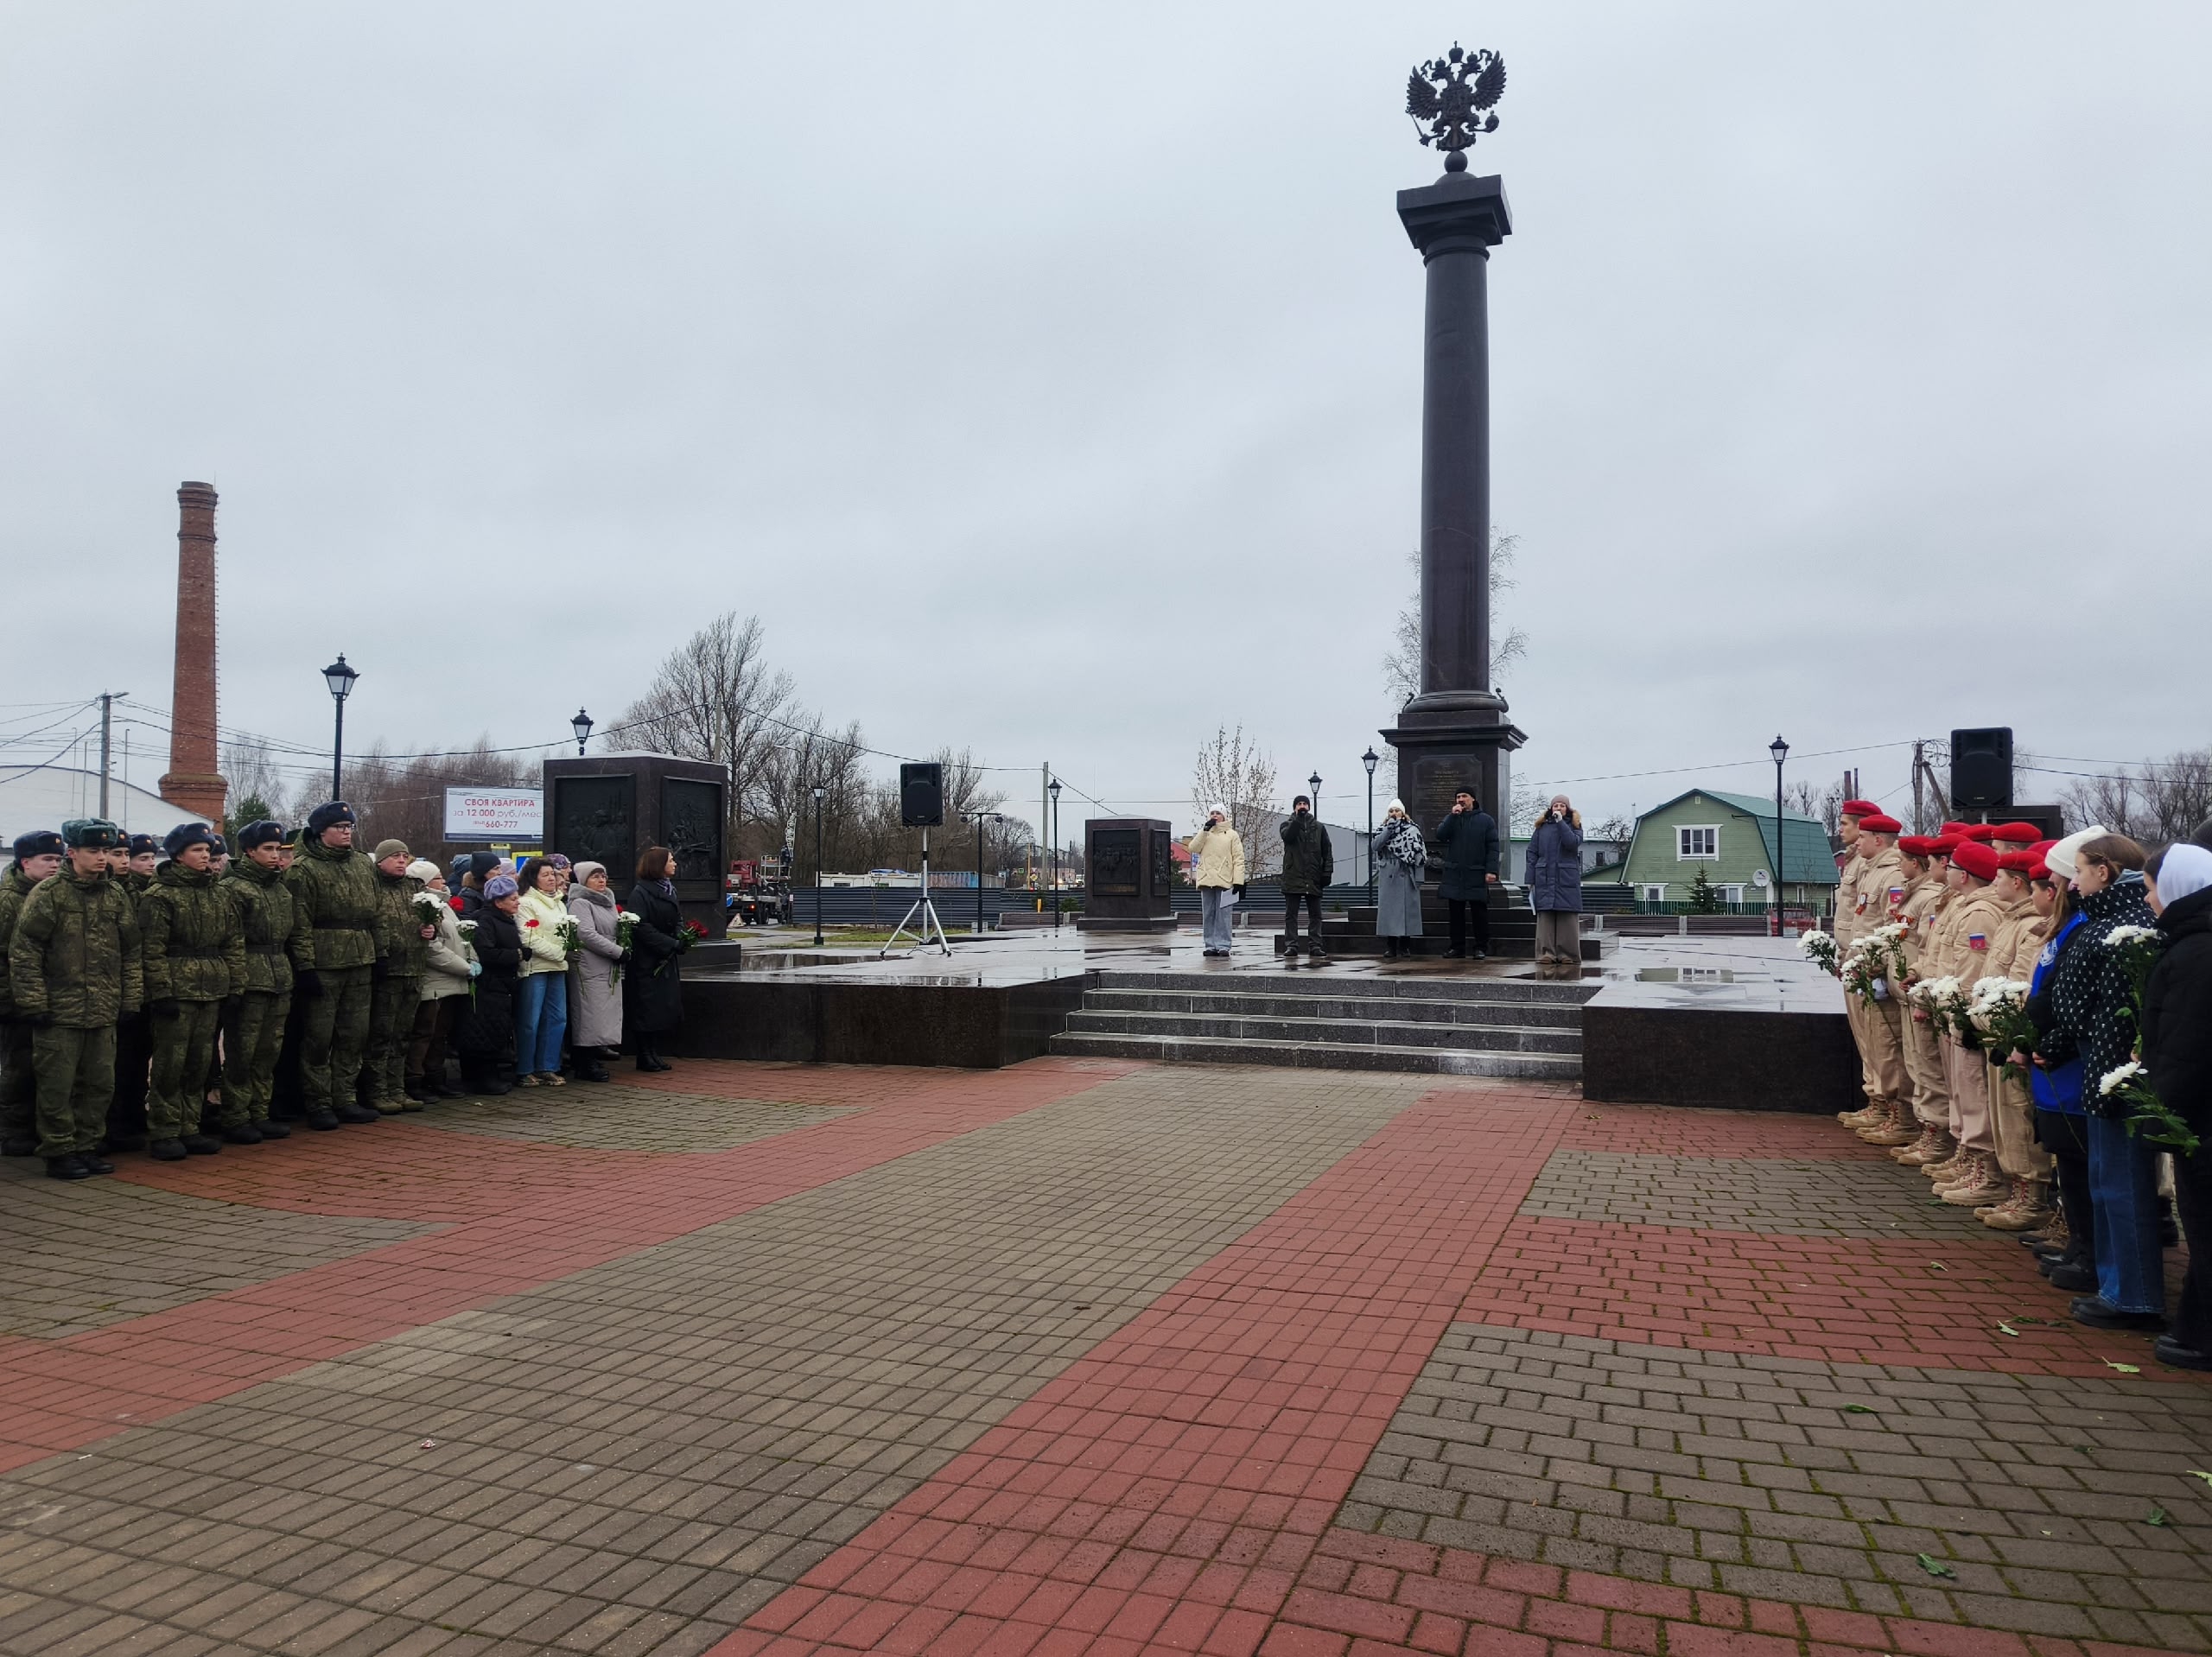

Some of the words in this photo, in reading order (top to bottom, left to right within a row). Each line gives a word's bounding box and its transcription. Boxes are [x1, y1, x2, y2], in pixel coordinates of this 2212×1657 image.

[464, 798, 489, 807] СВОЯ
[492, 798, 535, 808] КВАРТИРА
[479, 809, 495, 817] 000
